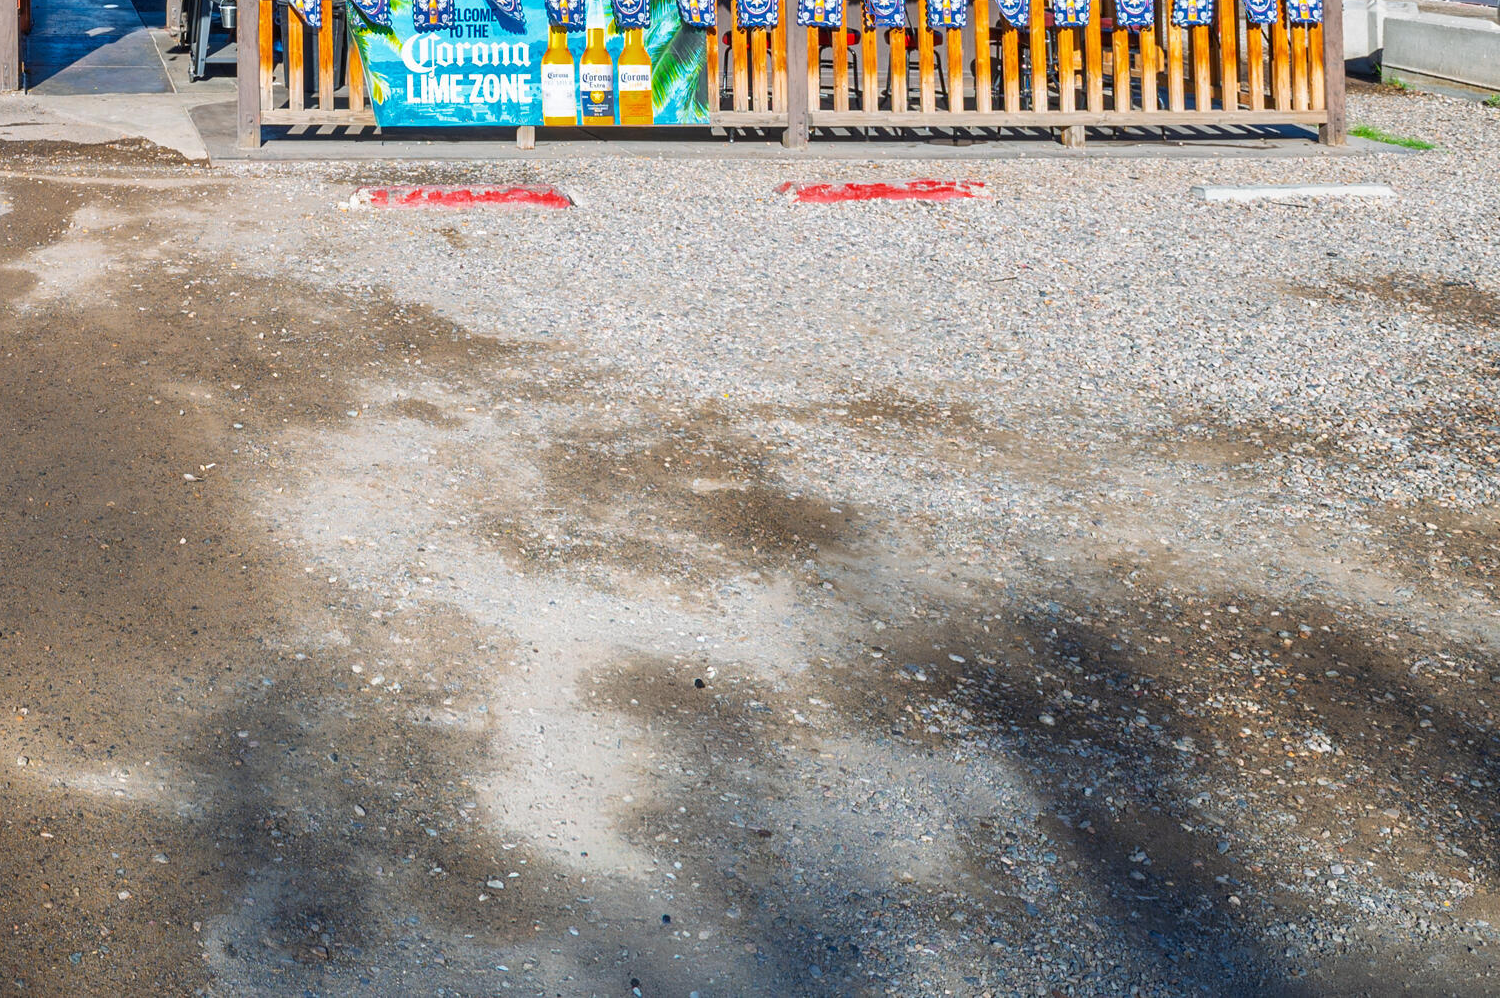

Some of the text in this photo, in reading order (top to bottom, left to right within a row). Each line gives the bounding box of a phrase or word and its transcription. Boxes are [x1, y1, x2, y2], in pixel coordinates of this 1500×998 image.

[453, 7, 497, 22] ELCOME
[450, 24, 489, 38] TO THE
[401, 33, 532, 79] Corona
[582, 73, 612, 83] Corona
[620, 73, 649, 82] Corona
[407, 73, 533, 103] LIME ZONE
